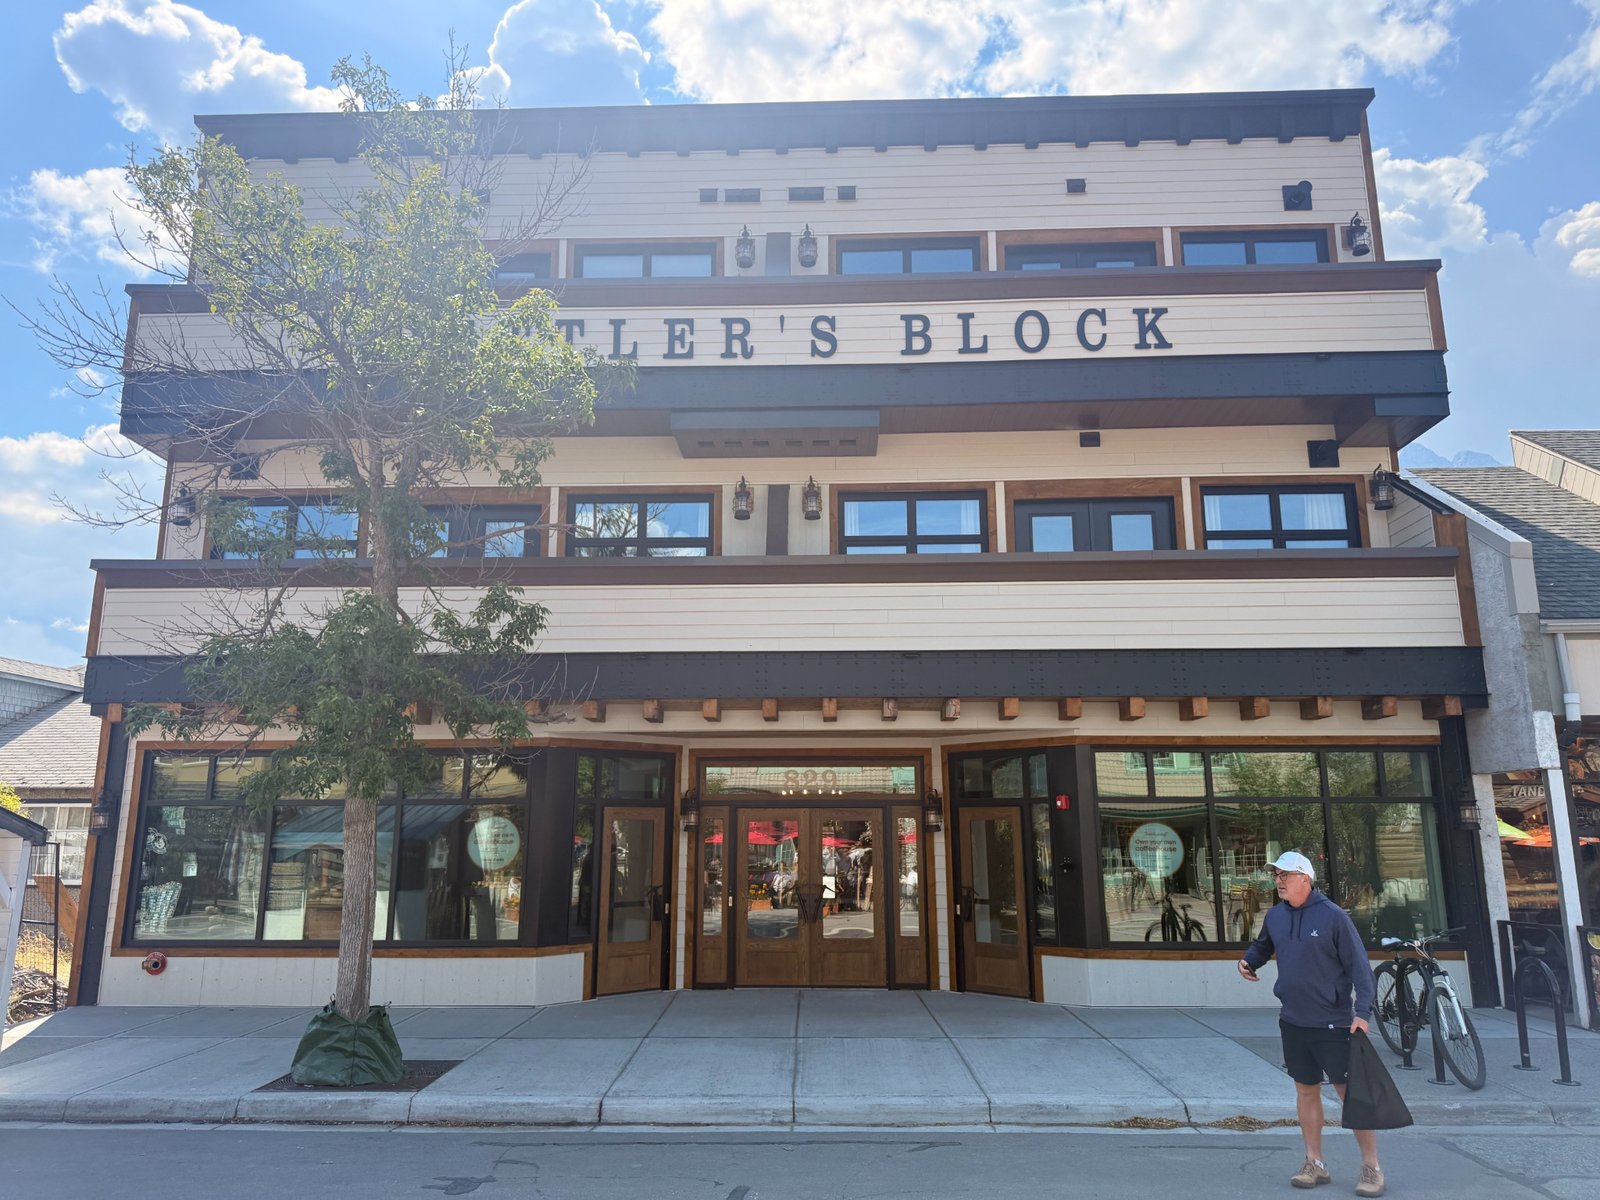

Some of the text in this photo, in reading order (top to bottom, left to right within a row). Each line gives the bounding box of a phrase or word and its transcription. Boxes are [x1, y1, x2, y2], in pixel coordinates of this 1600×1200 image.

[465, 307, 1173, 361] TLER'S BLOCK
[784, 769, 837, 791] 829
[1511, 784, 1546, 798] TAND
